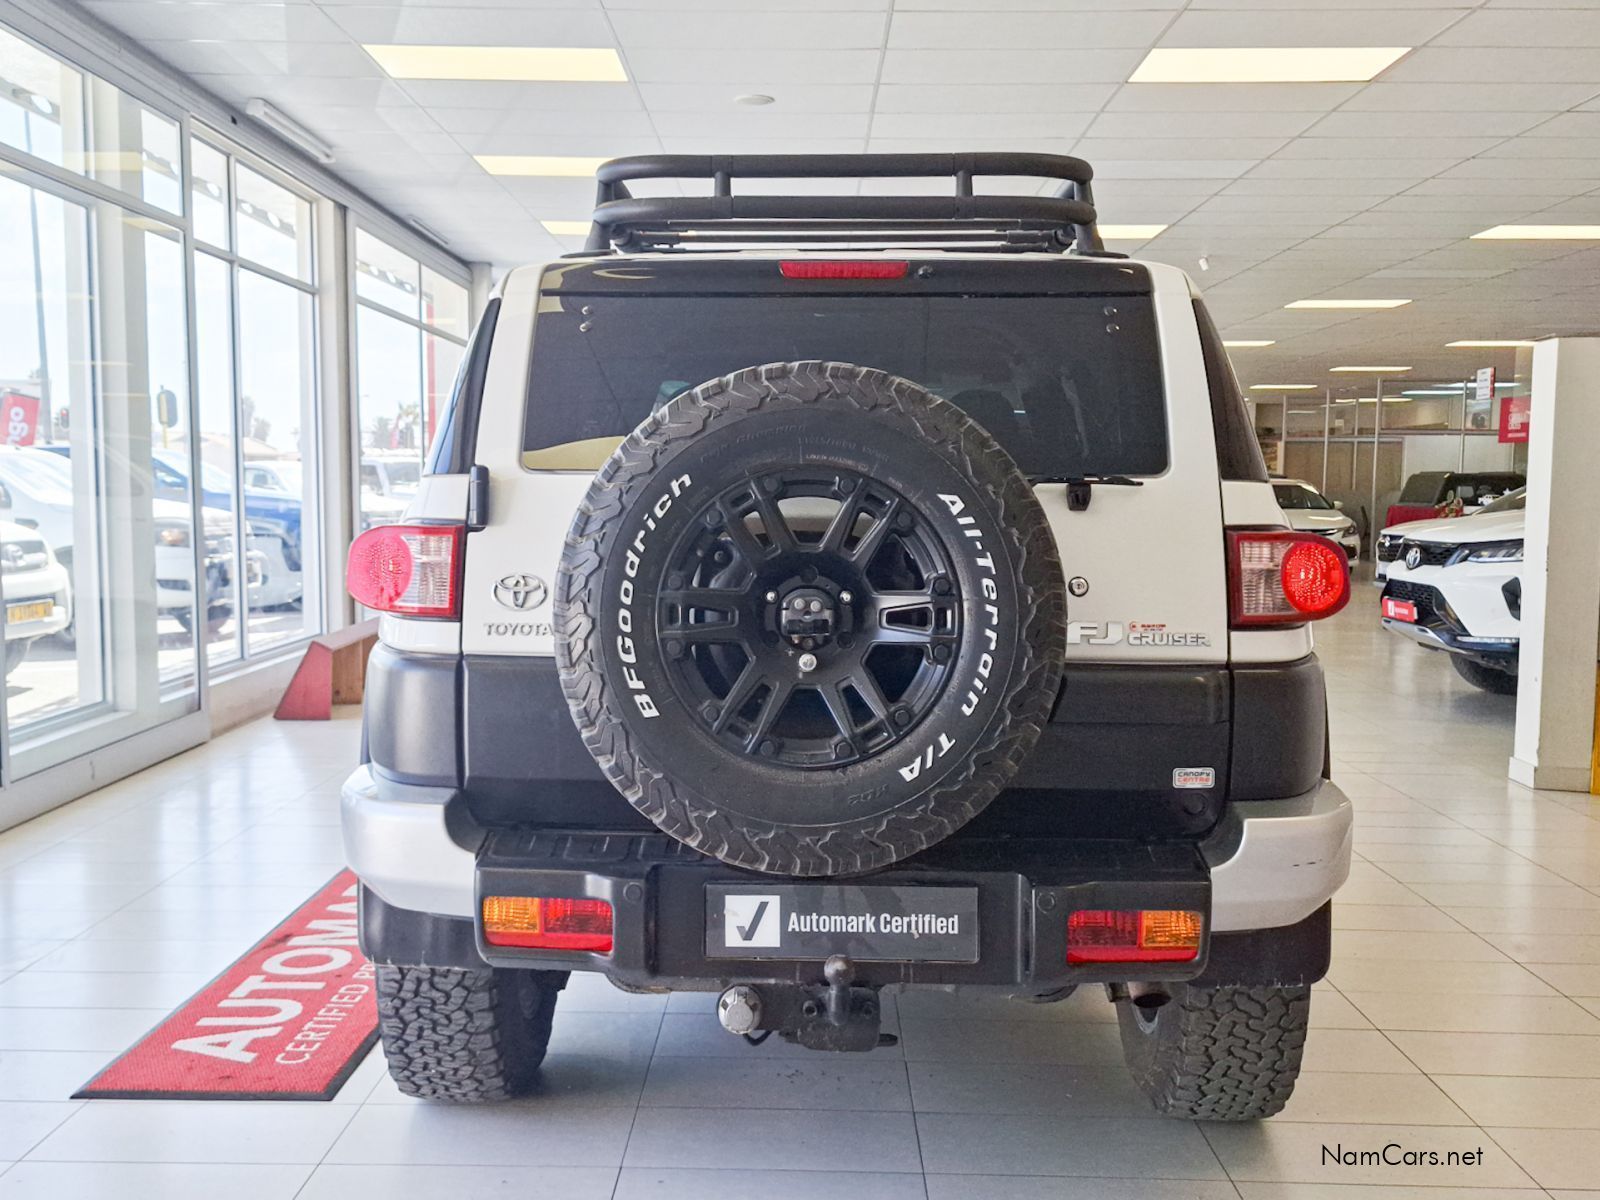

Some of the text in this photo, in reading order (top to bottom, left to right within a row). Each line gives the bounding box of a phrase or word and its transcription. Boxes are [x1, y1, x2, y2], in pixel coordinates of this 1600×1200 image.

[617, 473, 692, 719] BFGoodrich
[483, 622, 554, 637] TOYOTA
[898, 492, 999, 782] All-Terrain T/A
[1067, 622, 1123, 646] FJ
[1127, 632, 1212, 647] CRUISER
[787, 912, 959, 935] Automark Certified
[171, 884, 359, 1064] AUTOM
[275, 983, 370, 1065] CERTIFIED
